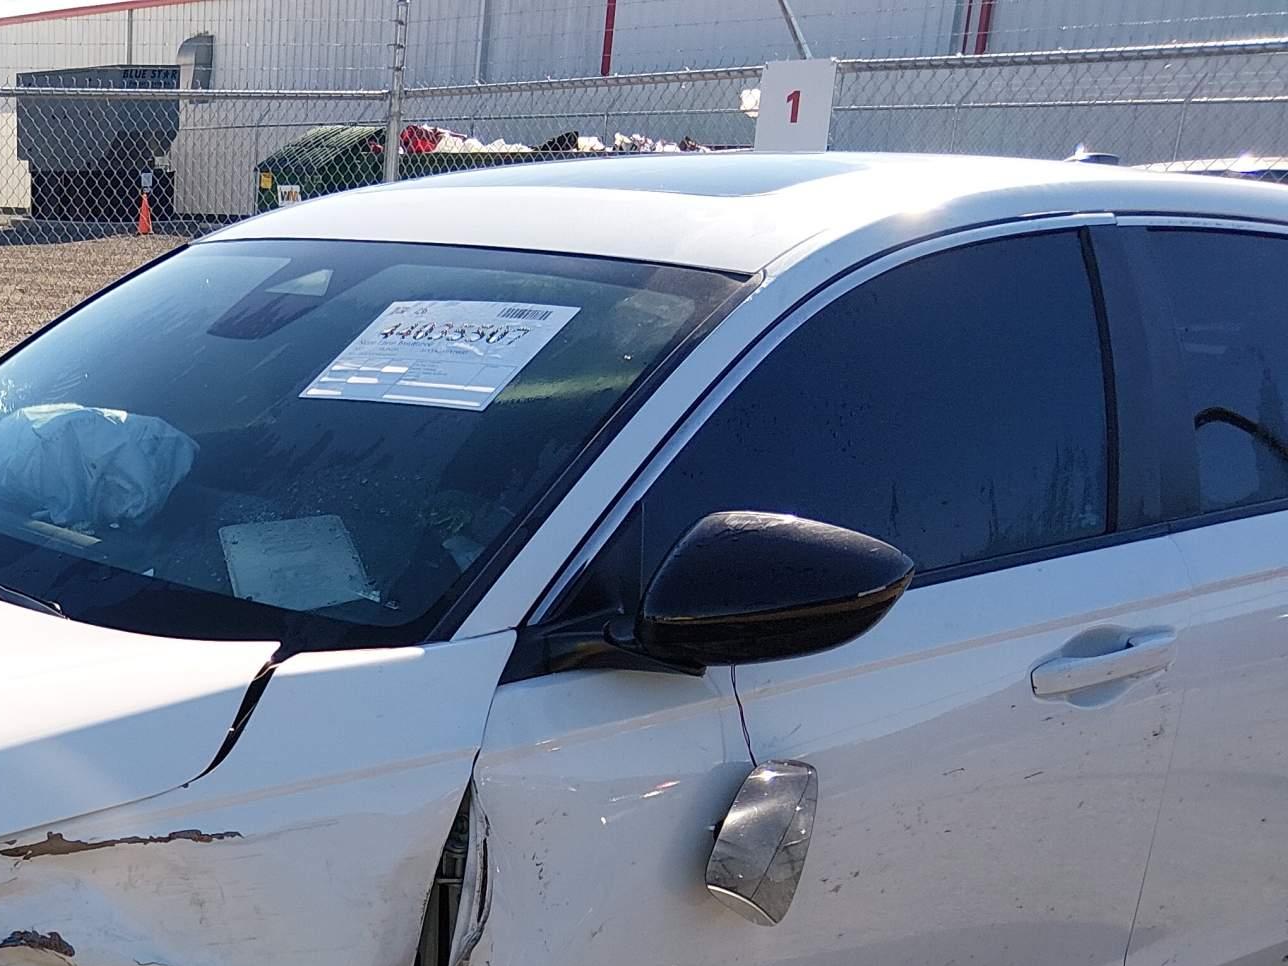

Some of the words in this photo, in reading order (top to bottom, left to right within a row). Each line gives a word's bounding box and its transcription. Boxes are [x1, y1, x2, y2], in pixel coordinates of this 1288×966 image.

[122, 69, 146, 79] BLUE
[786, 90, 801, 124] 1
[380, 321, 531, 346] 44035507
